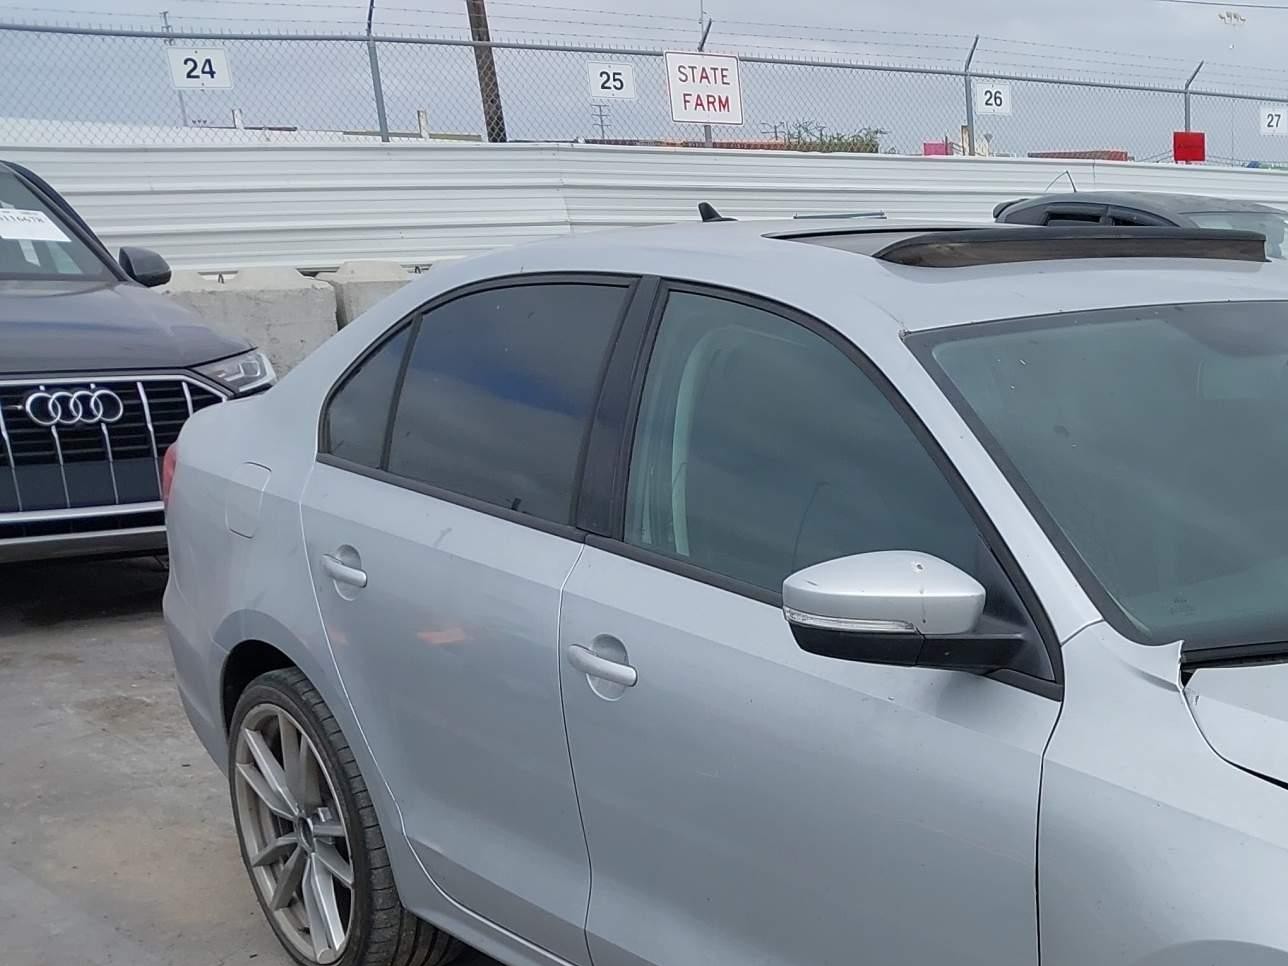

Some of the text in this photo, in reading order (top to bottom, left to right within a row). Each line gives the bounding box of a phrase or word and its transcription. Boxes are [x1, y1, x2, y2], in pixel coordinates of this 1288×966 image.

[183, 57, 216, 79] 24
[677, 65, 731, 86] STATE
[600, 70, 624, 91] 25
[682, 92, 731, 113] FARM
[984, 90, 1003, 107] 26
[1266, 113, 1281, 128] 27
